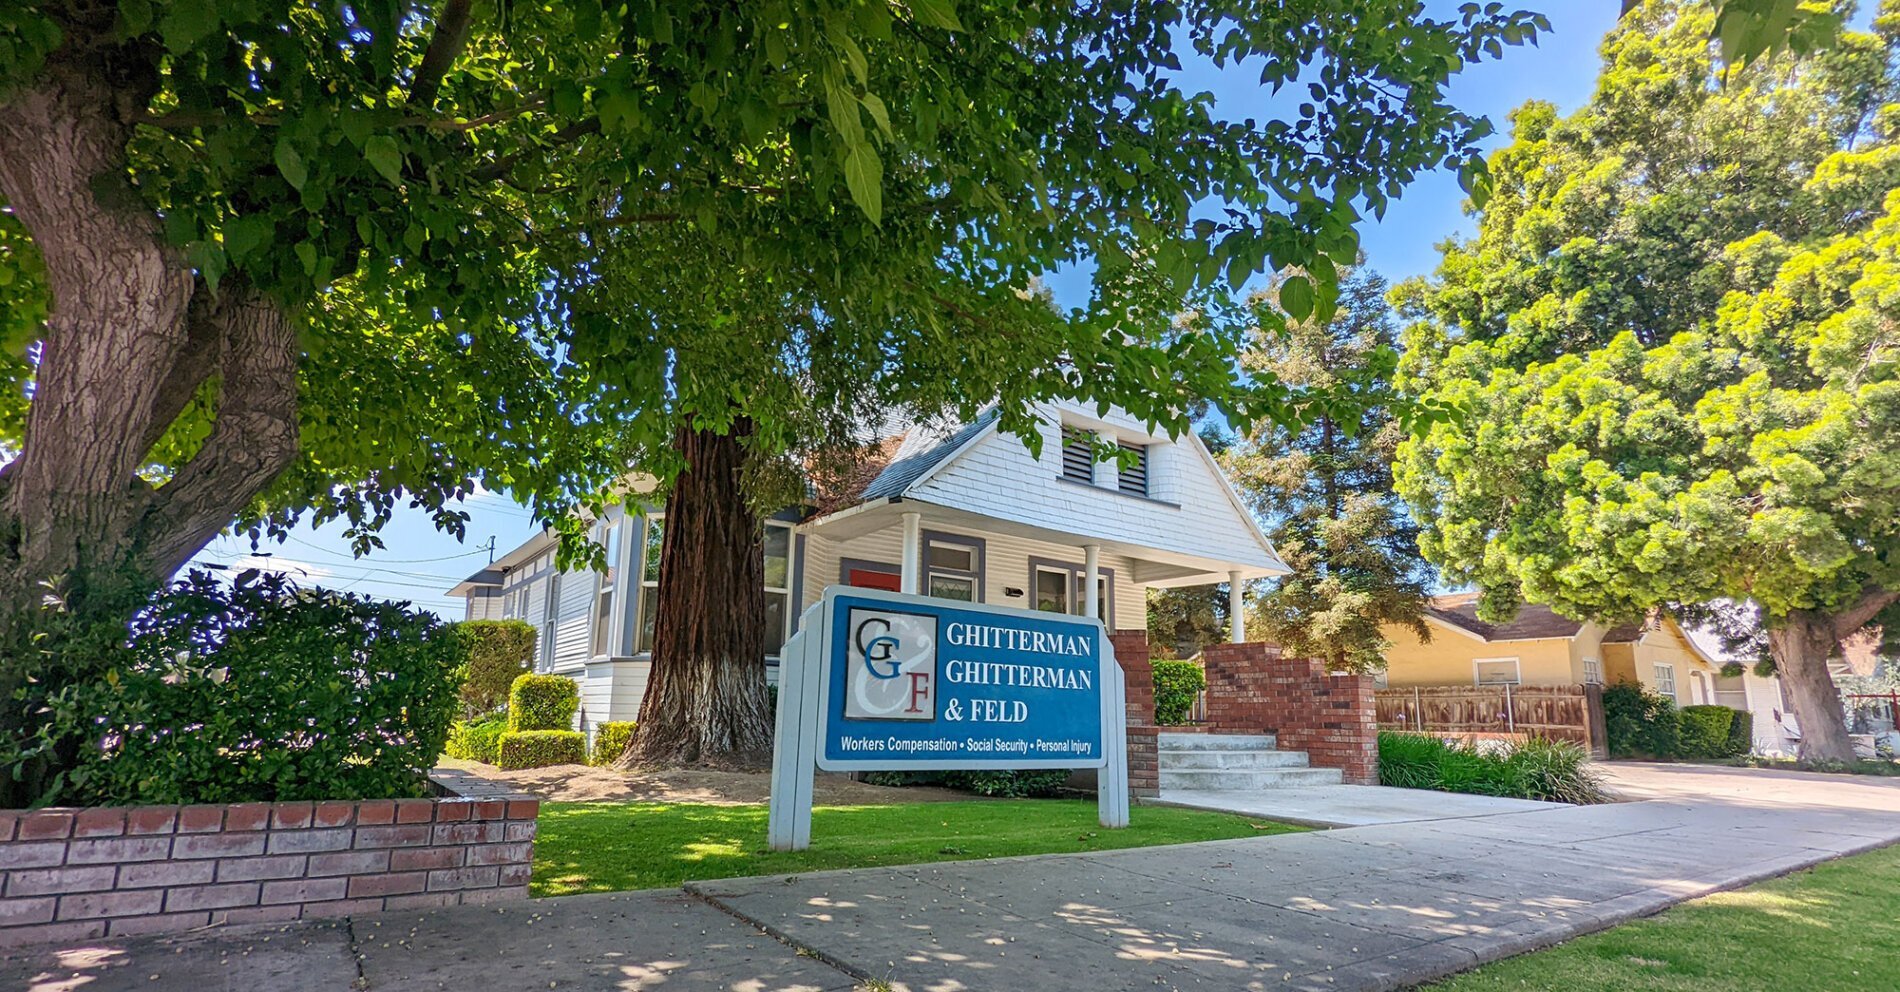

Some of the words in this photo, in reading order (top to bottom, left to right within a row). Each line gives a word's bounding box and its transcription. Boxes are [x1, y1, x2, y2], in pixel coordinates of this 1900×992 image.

[856, 618, 891, 660] G
[946, 623, 1091, 657] GHITTERMAN
[865, 636, 901, 679] G
[945, 660, 1091, 690] GHITTERMAN
[904, 672, 929, 713] F
[944, 697, 963, 721] &
[970, 699, 1028, 723] FELD
[841, 736, 885, 751] Workers
[887, 736, 957, 754] Compensation
[966, 737, 993, 752] Social
[995, 738, 1028, 755] Security
[1036, 738, 1069, 752] Personal
[1071, 739, 1092, 755] Injury
